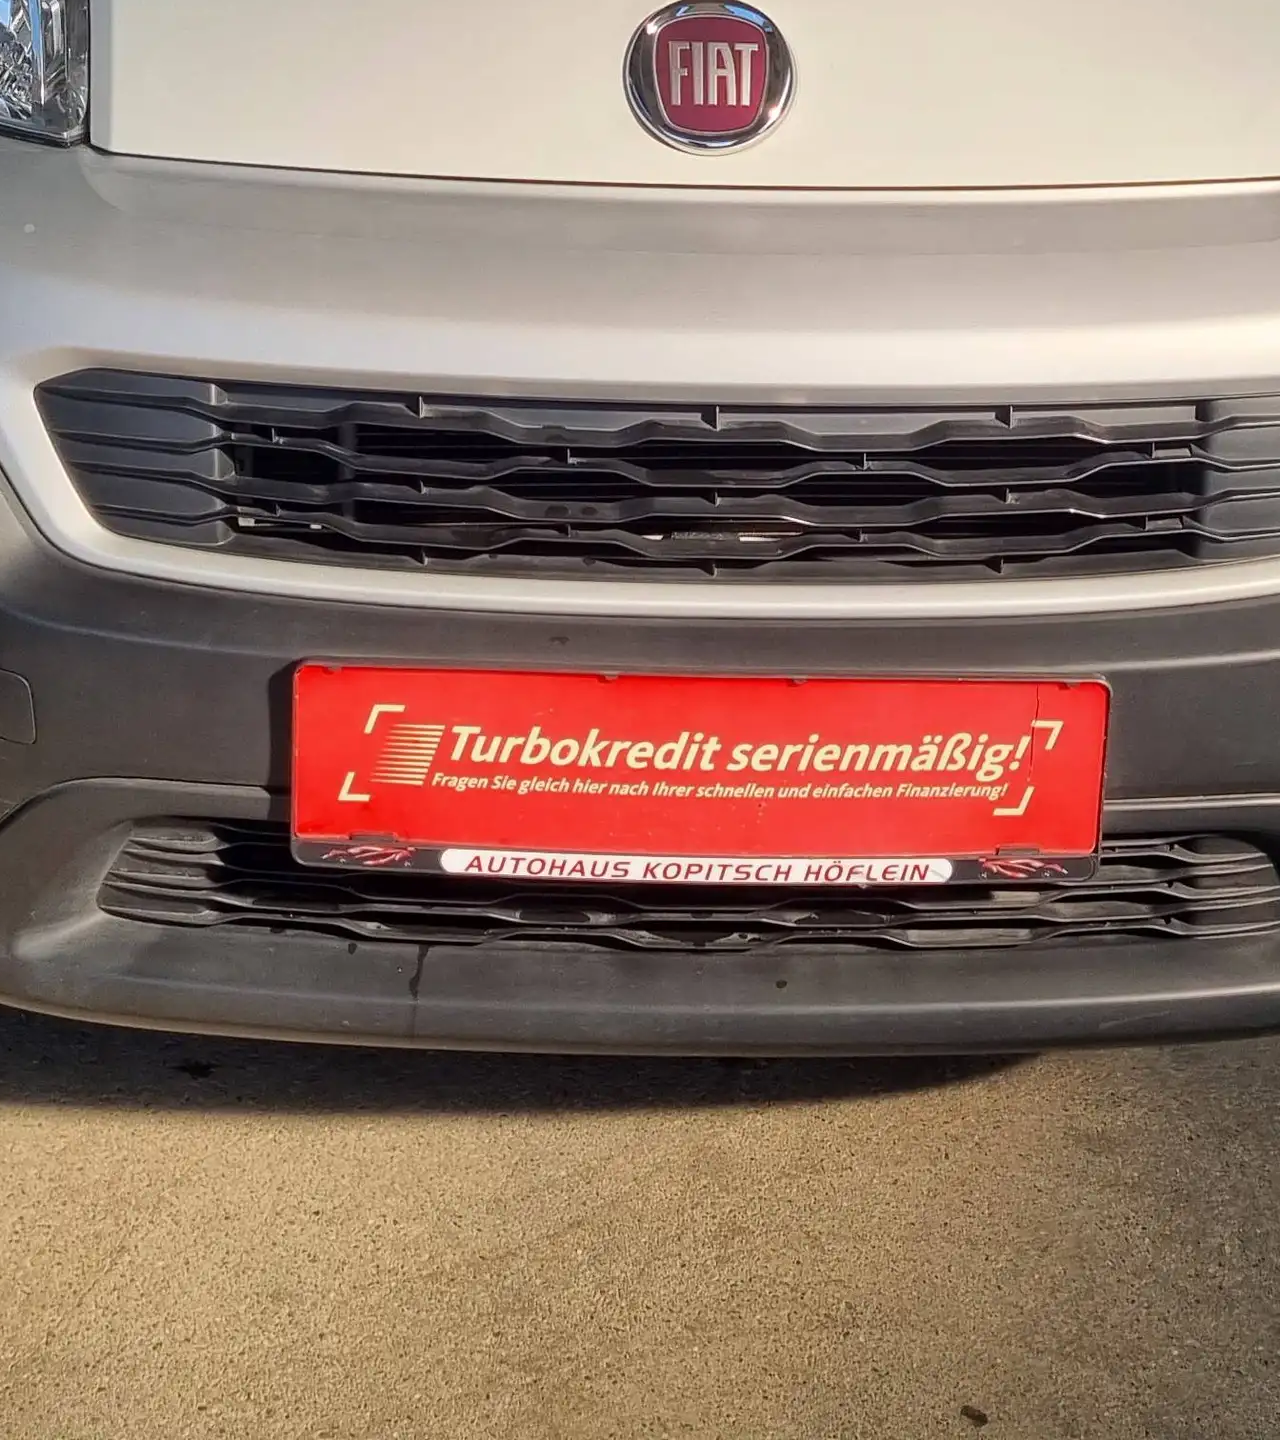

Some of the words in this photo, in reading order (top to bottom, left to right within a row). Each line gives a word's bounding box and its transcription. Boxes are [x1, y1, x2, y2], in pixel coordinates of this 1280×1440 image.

[668, 41, 759, 106] FIAT
[450, 725, 721, 772] Turbokredit
[726, 732, 1031, 783] serienmäßig!
[432, 772, 488, 792] Fragen
[491, 776, 517, 790] Sie
[517, 777, 570, 794] gleich
[572, 779, 608, 795] hier
[608, 780, 650, 796] nach
[652, 781, 696, 798] Ihrer
[696, 782, 775, 799] schnellen
[777, 783, 812, 799] und
[812, 782, 894, 799] einfachen
[896, 782, 1009, 801] Finanzierung!
[464, 854, 631, 878] AUTOHAUS
[642, 861, 793, 882] KOPITSCH
[803, 859, 930, 882] HÖFLEIN
